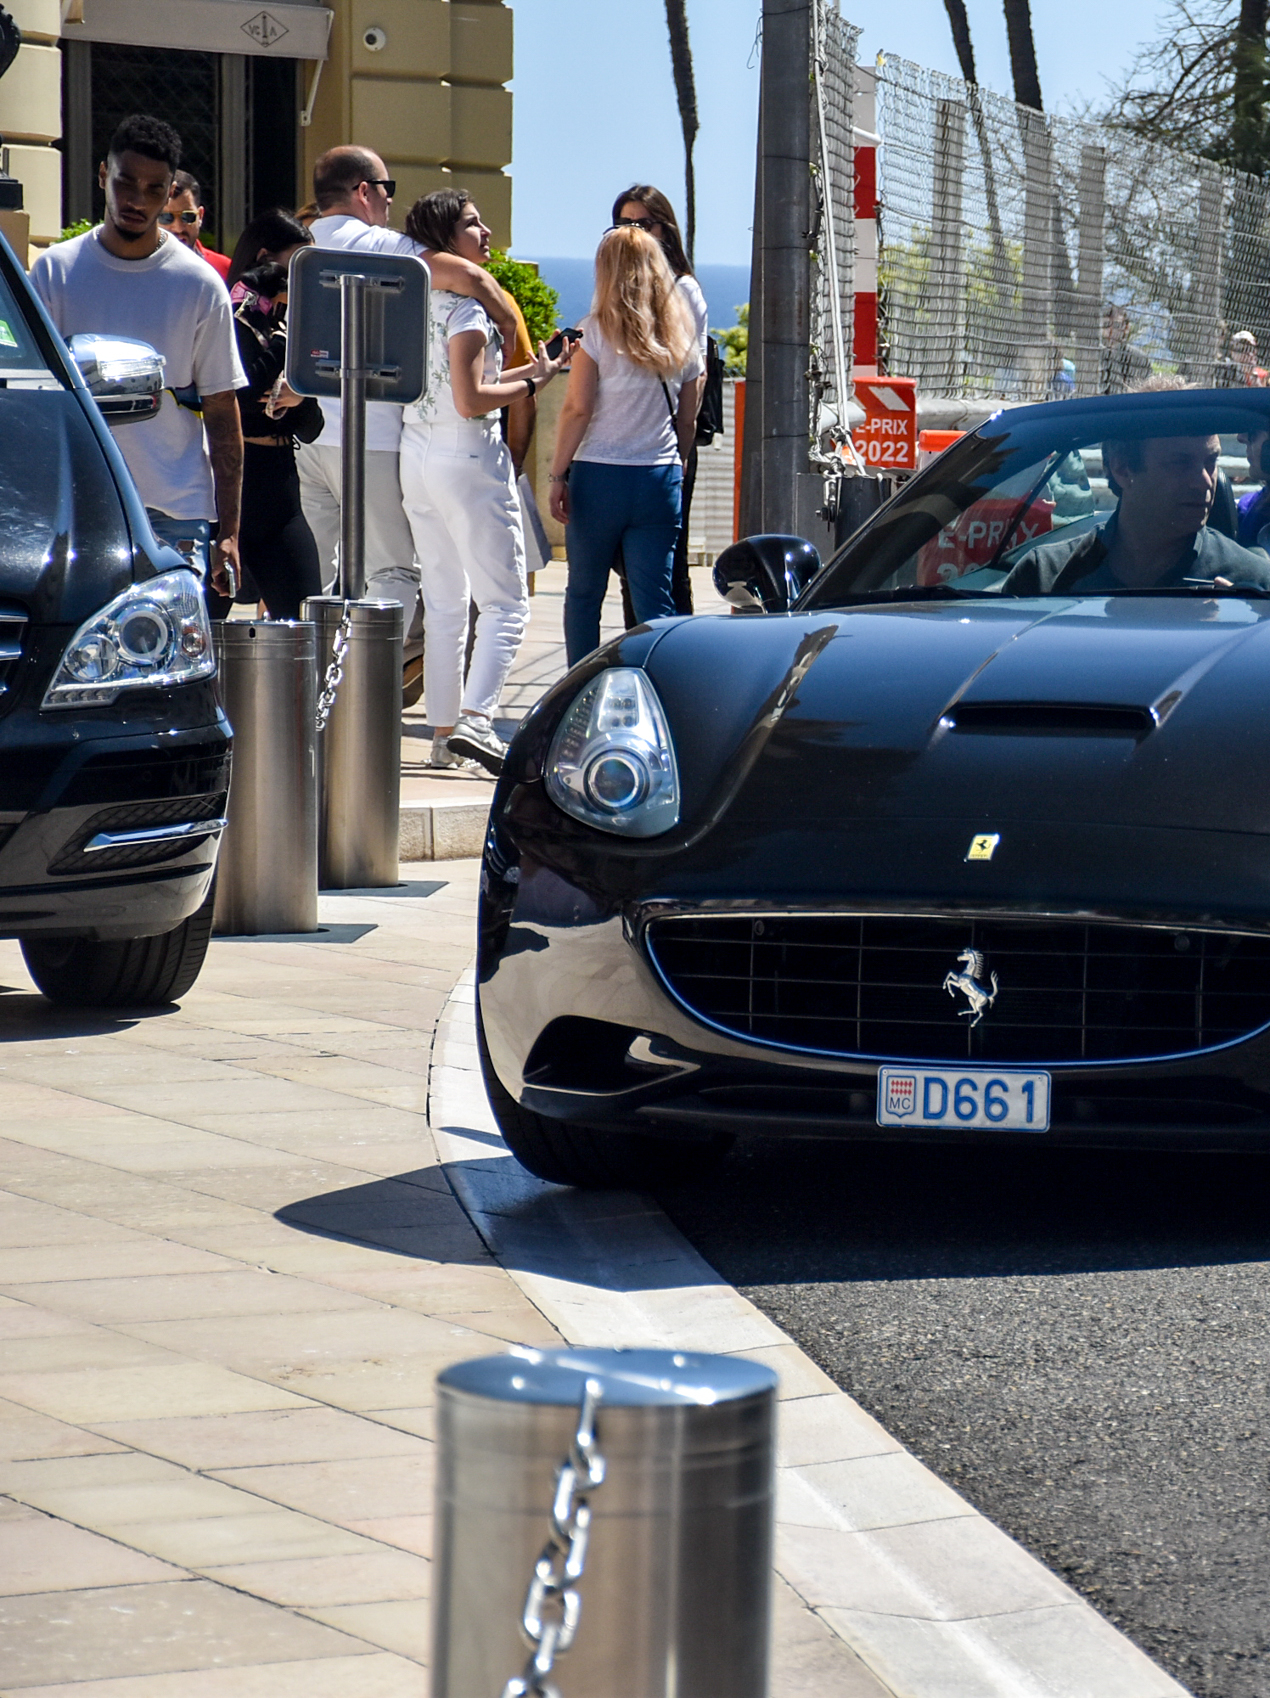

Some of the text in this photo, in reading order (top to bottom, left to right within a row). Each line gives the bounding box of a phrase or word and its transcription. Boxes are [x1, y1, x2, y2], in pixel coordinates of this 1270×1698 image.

[855, 440, 909, 463] 2022
[889, 1077, 1034, 1123] MC D661
